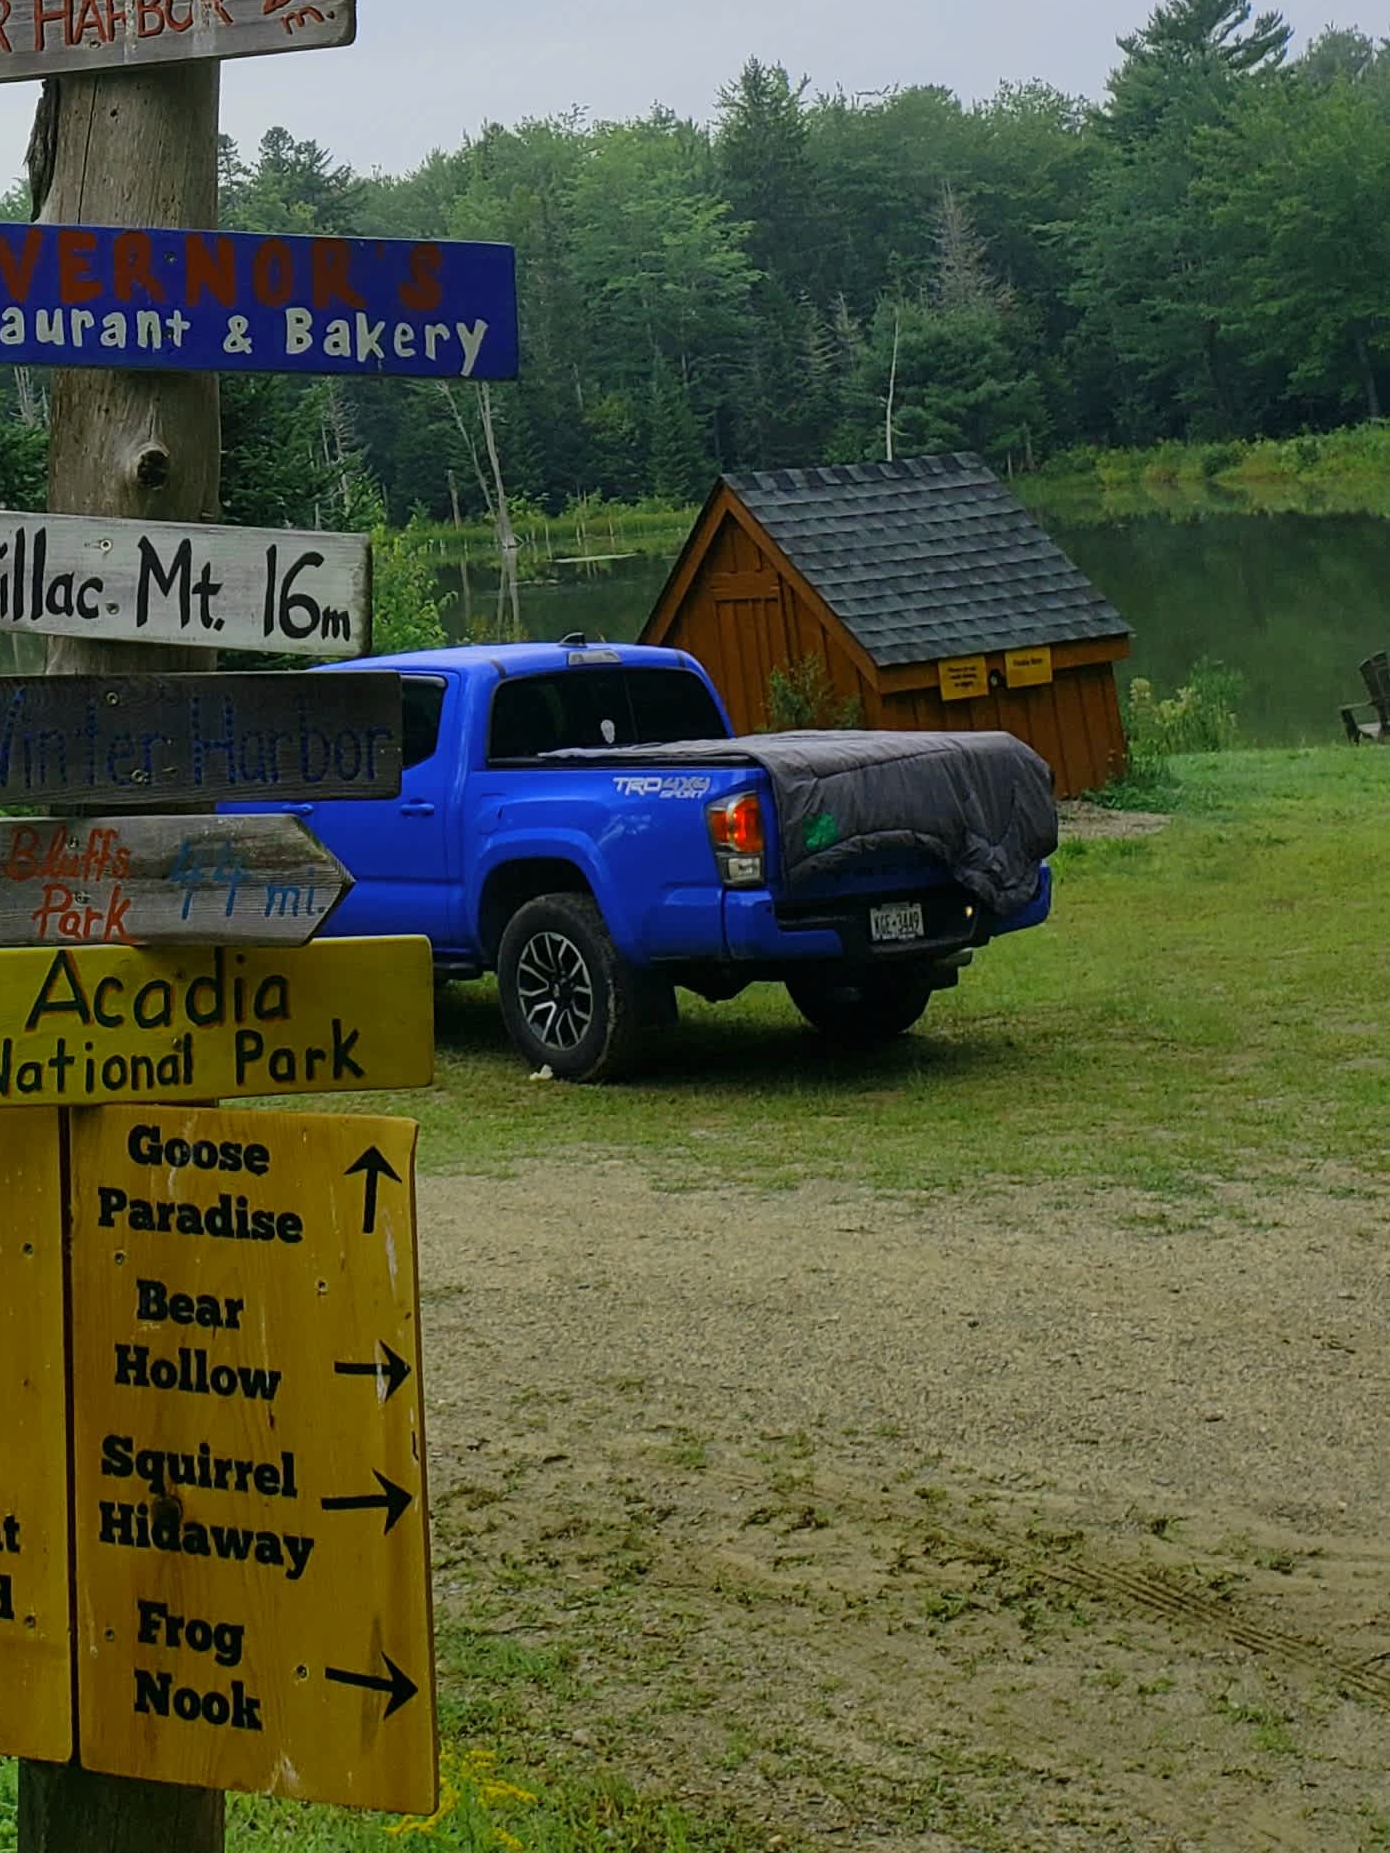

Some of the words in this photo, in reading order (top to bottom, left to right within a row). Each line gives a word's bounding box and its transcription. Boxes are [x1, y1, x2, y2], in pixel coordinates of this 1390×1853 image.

[222, 313, 254, 355] &
[285, 306, 489, 377] Bakery
[136, 535, 226, 632] Mt.
[191, 692, 395, 785] Harbor
[5, 826, 132, 883] Bluffs
[33, 883, 137, 944] Park
[25, 950, 291, 1031] Acadia
[235, 1019, 367, 1086] Park
[128, 1126, 270, 1176] Goose
[97, 1188, 303, 1244] Paradise
[136, 1279, 244, 1330] Bear
[114, 1345, 281, 1400] Hollow
[100, 1436, 298, 1498] Squirrel
[99, 1502, 314, 1579] Hidaway
[136, 1601, 245, 1667] Frog
[133, 1670, 263, 1730] Nook
